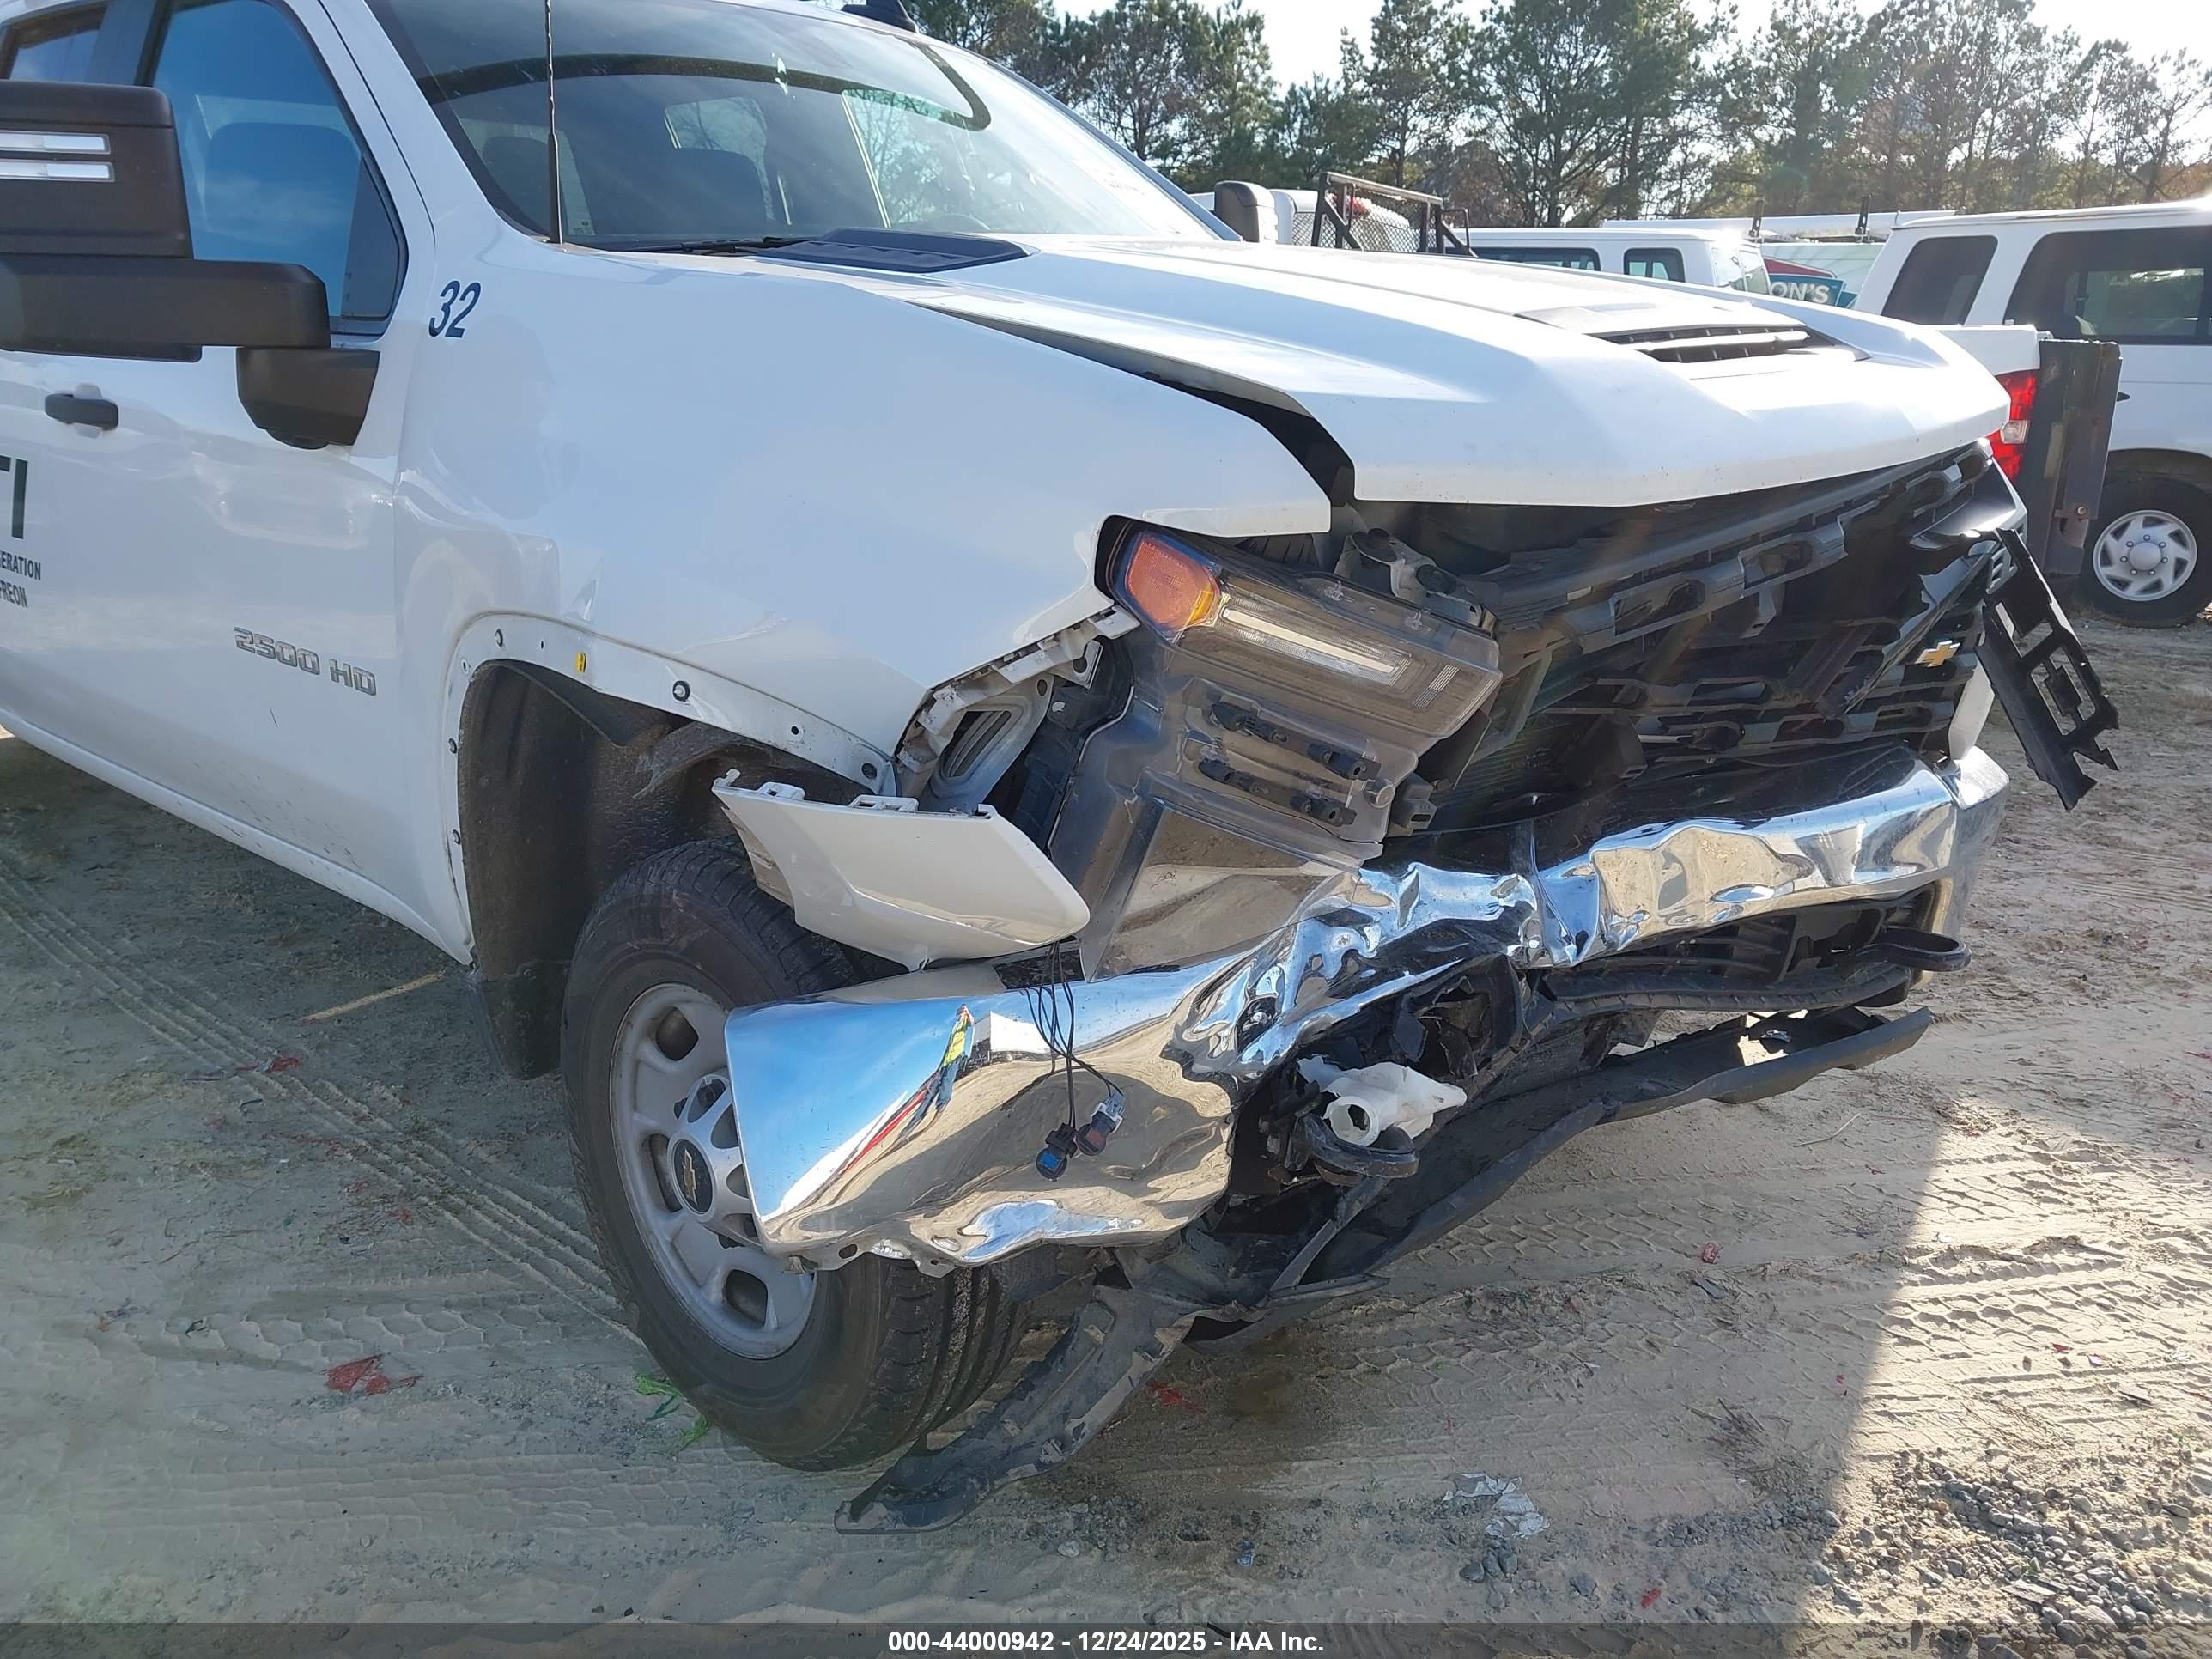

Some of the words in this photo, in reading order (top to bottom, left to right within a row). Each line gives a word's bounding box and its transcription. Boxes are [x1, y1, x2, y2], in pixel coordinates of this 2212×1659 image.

[428, 280, 482, 339] 32
[0, 550, 41, 581] ERATION
[234, 626, 321, 676] 2500
[329, 658, 377, 696] HD
